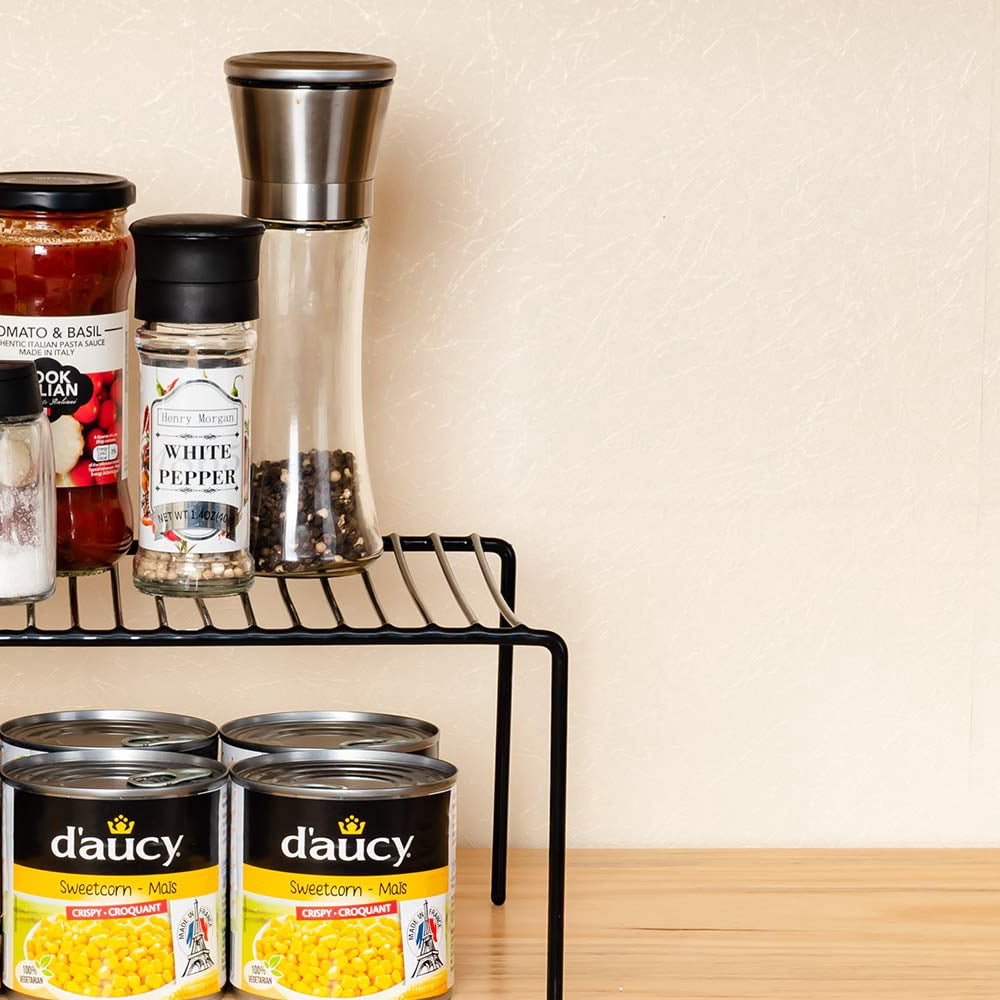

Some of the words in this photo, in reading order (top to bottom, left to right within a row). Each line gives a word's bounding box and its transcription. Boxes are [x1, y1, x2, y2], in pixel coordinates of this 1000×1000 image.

[53, 327, 62, 338] &
[68, 325, 102, 338] BASIL
[28, 340, 57, 348] ITALIAN
[60, 340, 83, 348] PASTA
[85, 339, 105, 347] SAUCE
[36, 370, 71, 384] OOK
[40, 383, 78, 396] LIAN
[161, 412, 192, 425] Henry
[199, 412, 234, 425] Morgan
[164, 444, 231, 460] WHITE
[159, 469, 235, 485] PEPPER
[158, 512, 172, 523] NET
[174, 510, 188, 520] WT
[51, 826, 184, 867] d'aucy
[281, 826, 414, 867] d'aucy
[60, 880, 132, 896] Sweetcorn
[290, 880, 362, 896] Sweetcorn
[72, 909, 102, 917] CRISPY
[108, 903, 161, 916] CROQUANT
[302, 909, 332, 918] CRISPY
[338, 904, 391, 917] CROQUANT
[179, 919, 187, 940] MADE
[409, 919, 417, 940] MADE
